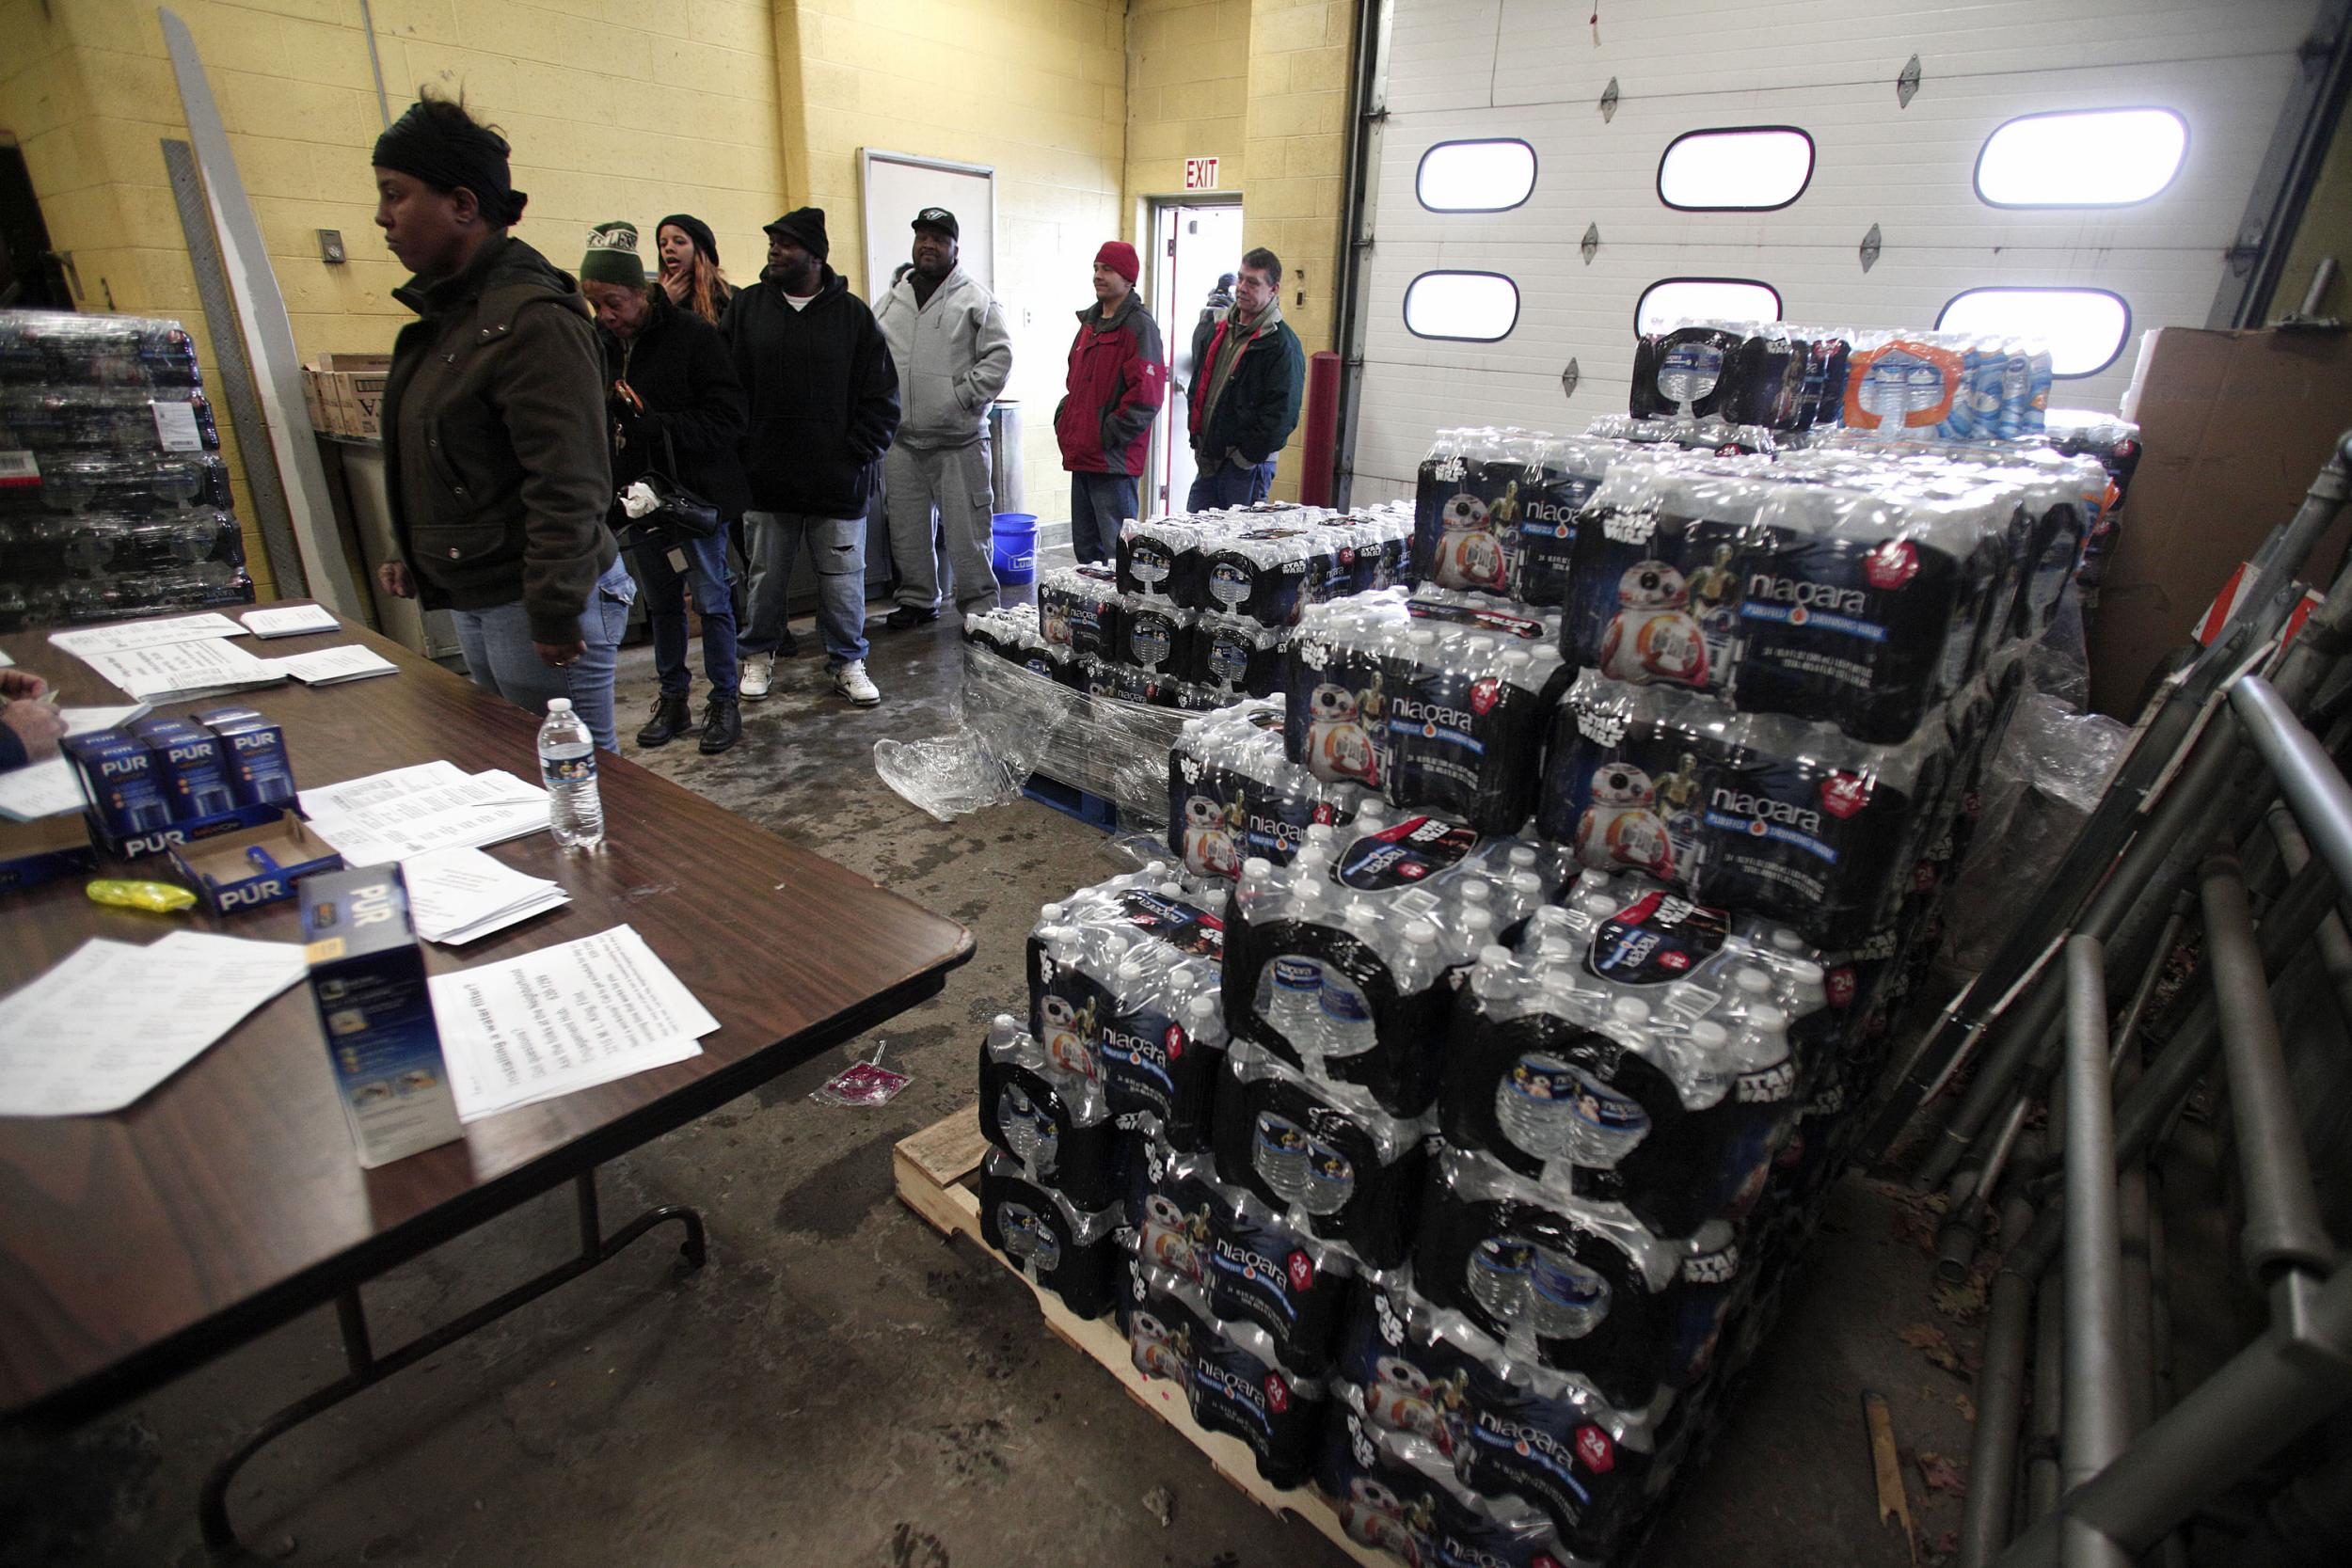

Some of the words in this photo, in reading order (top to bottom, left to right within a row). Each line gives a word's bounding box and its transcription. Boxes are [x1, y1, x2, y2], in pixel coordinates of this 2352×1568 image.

[1186, 159, 1217, 188] EXIT
[1526, 500, 1583, 524] niaga
[1749, 572, 1867, 616] niagara
[1071, 609, 1098, 621] niagara
[1118, 689, 1147, 705] niagara
[1391, 696, 1472, 733] niagara
[169, 743, 213, 764] PUR
[233, 732, 277, 751] PUR
[101, 754, 149, 777] PUR
[1710, 786, 1822, 833] niagara
[1249, 814, 1308, 841] niagar
[126, 830, 186, 858] PUR
[218, 879, 282, 911] PUR
[349, 883, 393, 928] PUR
[463, 983, 485, 1007] filter?
[477, 1007, 497, 1033] water
[510, 1027, 543, 1064] questions?
[1103, 1026, 1167, 1069] niagara
[492, 1039, 520, 1087] Installing
[1216, 1237, 1288, 1291] niagara
[1293, 1255, 1308, 1278] 24
[1198, 1356, 1265, 1409] niagara
[1270, 1378, 1283, 1402] 24
[1476, 1427, 1513, 1448] PURIFIED
[1479, 1410, 1574, 1471] niagara
[1582, 1430, 1607, 1457] 24
